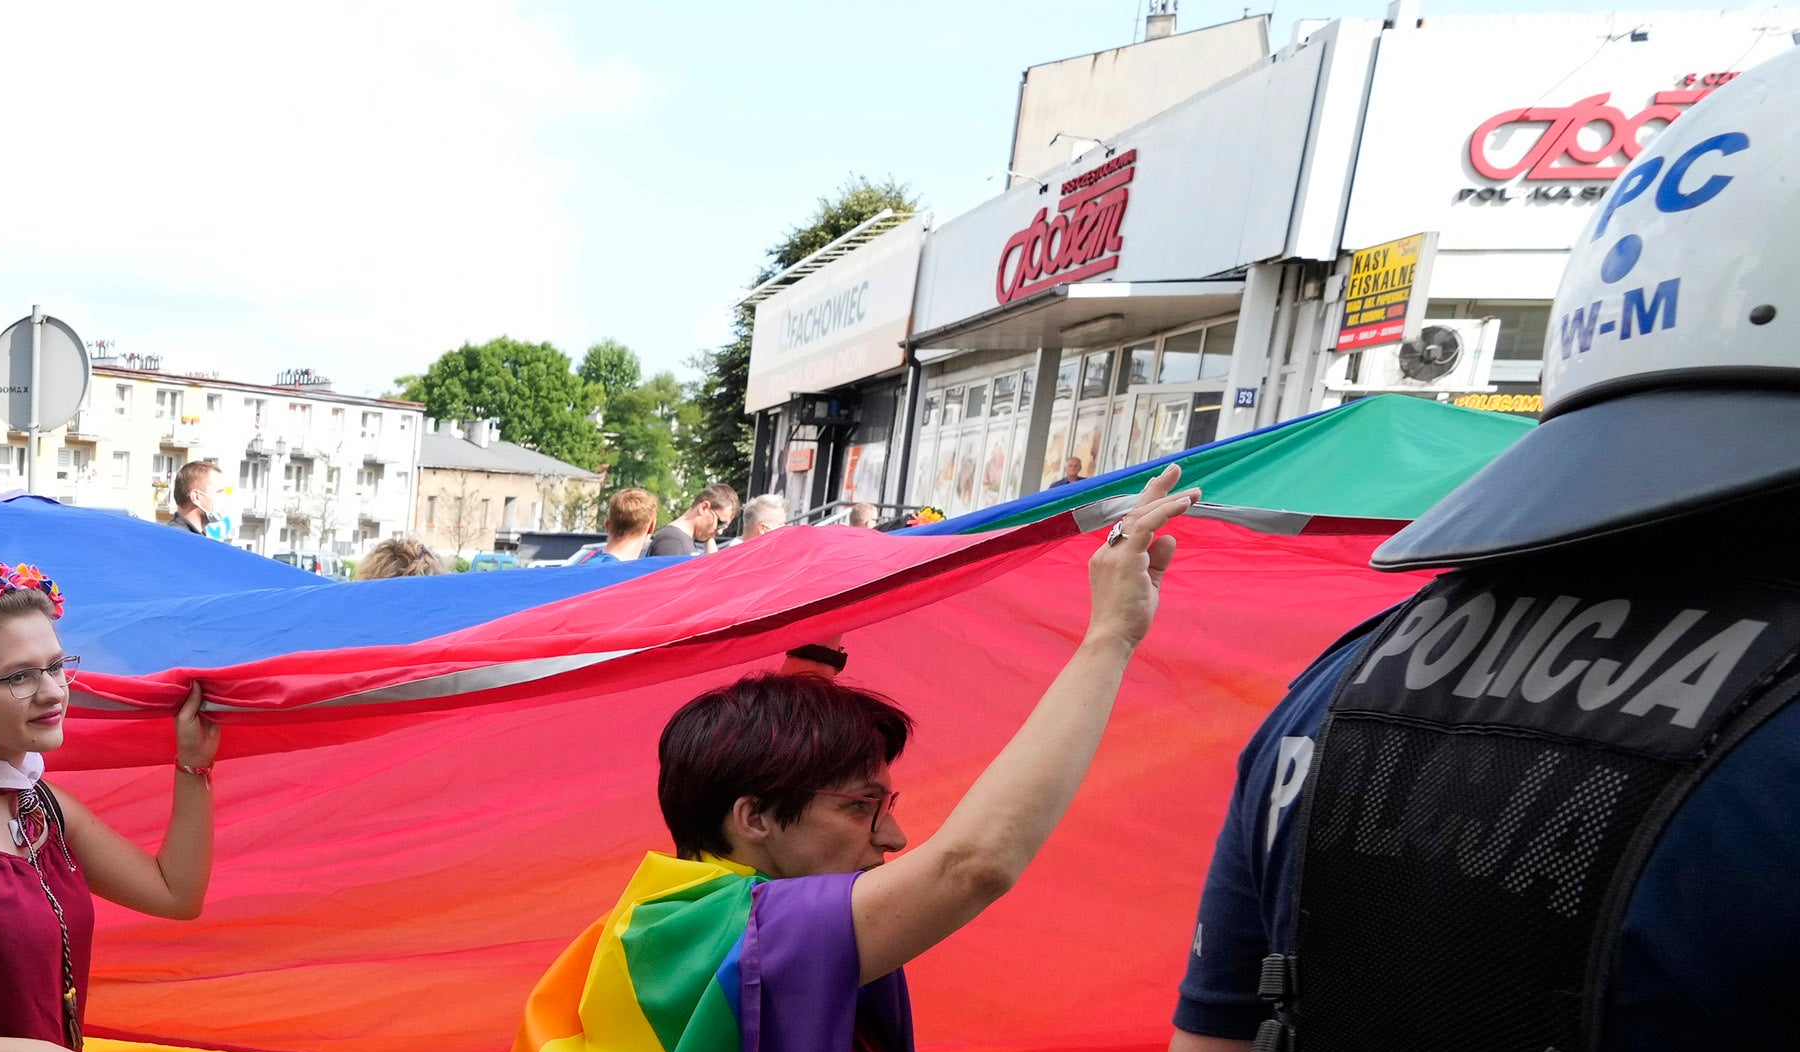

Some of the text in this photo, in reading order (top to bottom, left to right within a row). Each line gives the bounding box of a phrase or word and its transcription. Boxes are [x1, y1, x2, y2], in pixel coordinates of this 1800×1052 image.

[1591, 131, 1750, 243] PC
[1349, 263, 1416, 297] FISKALNE
[1353, 248, 1390, 275] KASY
[789, 281, 869, 350] FACHOWIEC
[1561, 277, 1681, 360] W-M
[1238, 391, 1253, 404] 52
[1354, 592, 1769, 729] POLICJA
